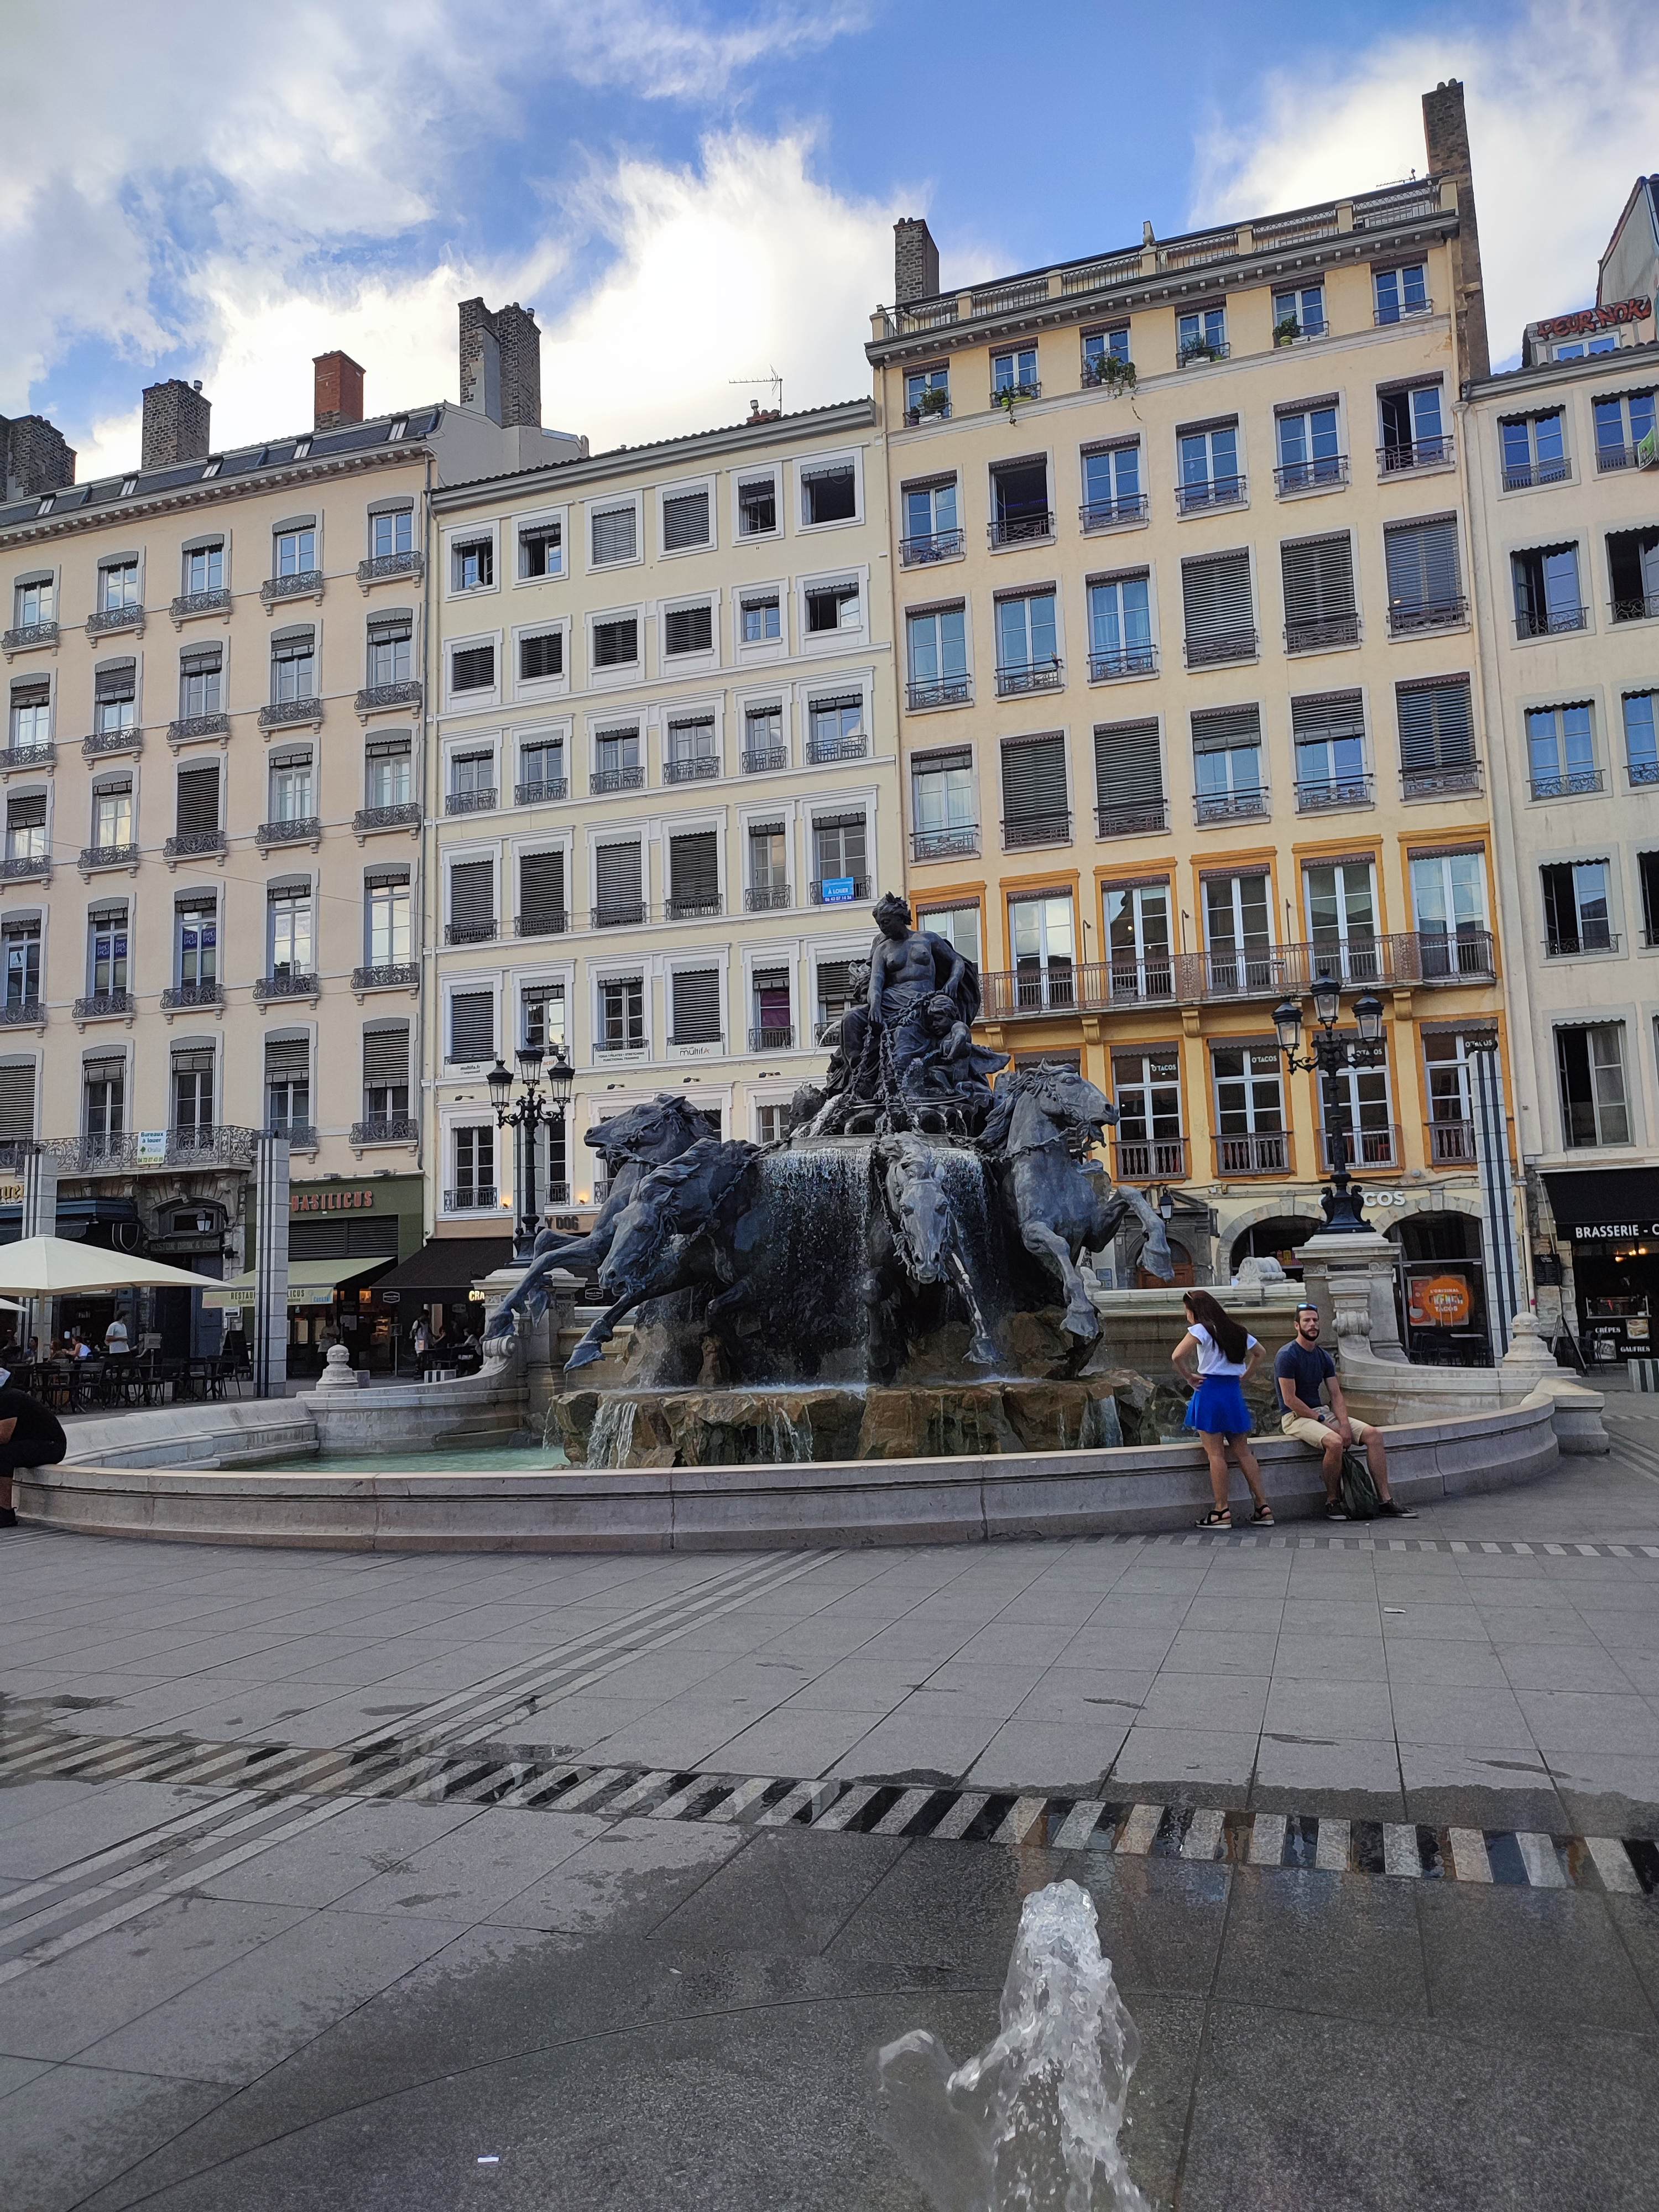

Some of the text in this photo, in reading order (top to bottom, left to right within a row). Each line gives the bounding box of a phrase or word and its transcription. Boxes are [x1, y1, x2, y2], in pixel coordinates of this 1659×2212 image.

[291, 1191, 372, 1212] BASILICUS
[556, 1216, 579, 1230] DOG
[1575, 1224, 1639, 1238] BRASSERIE
